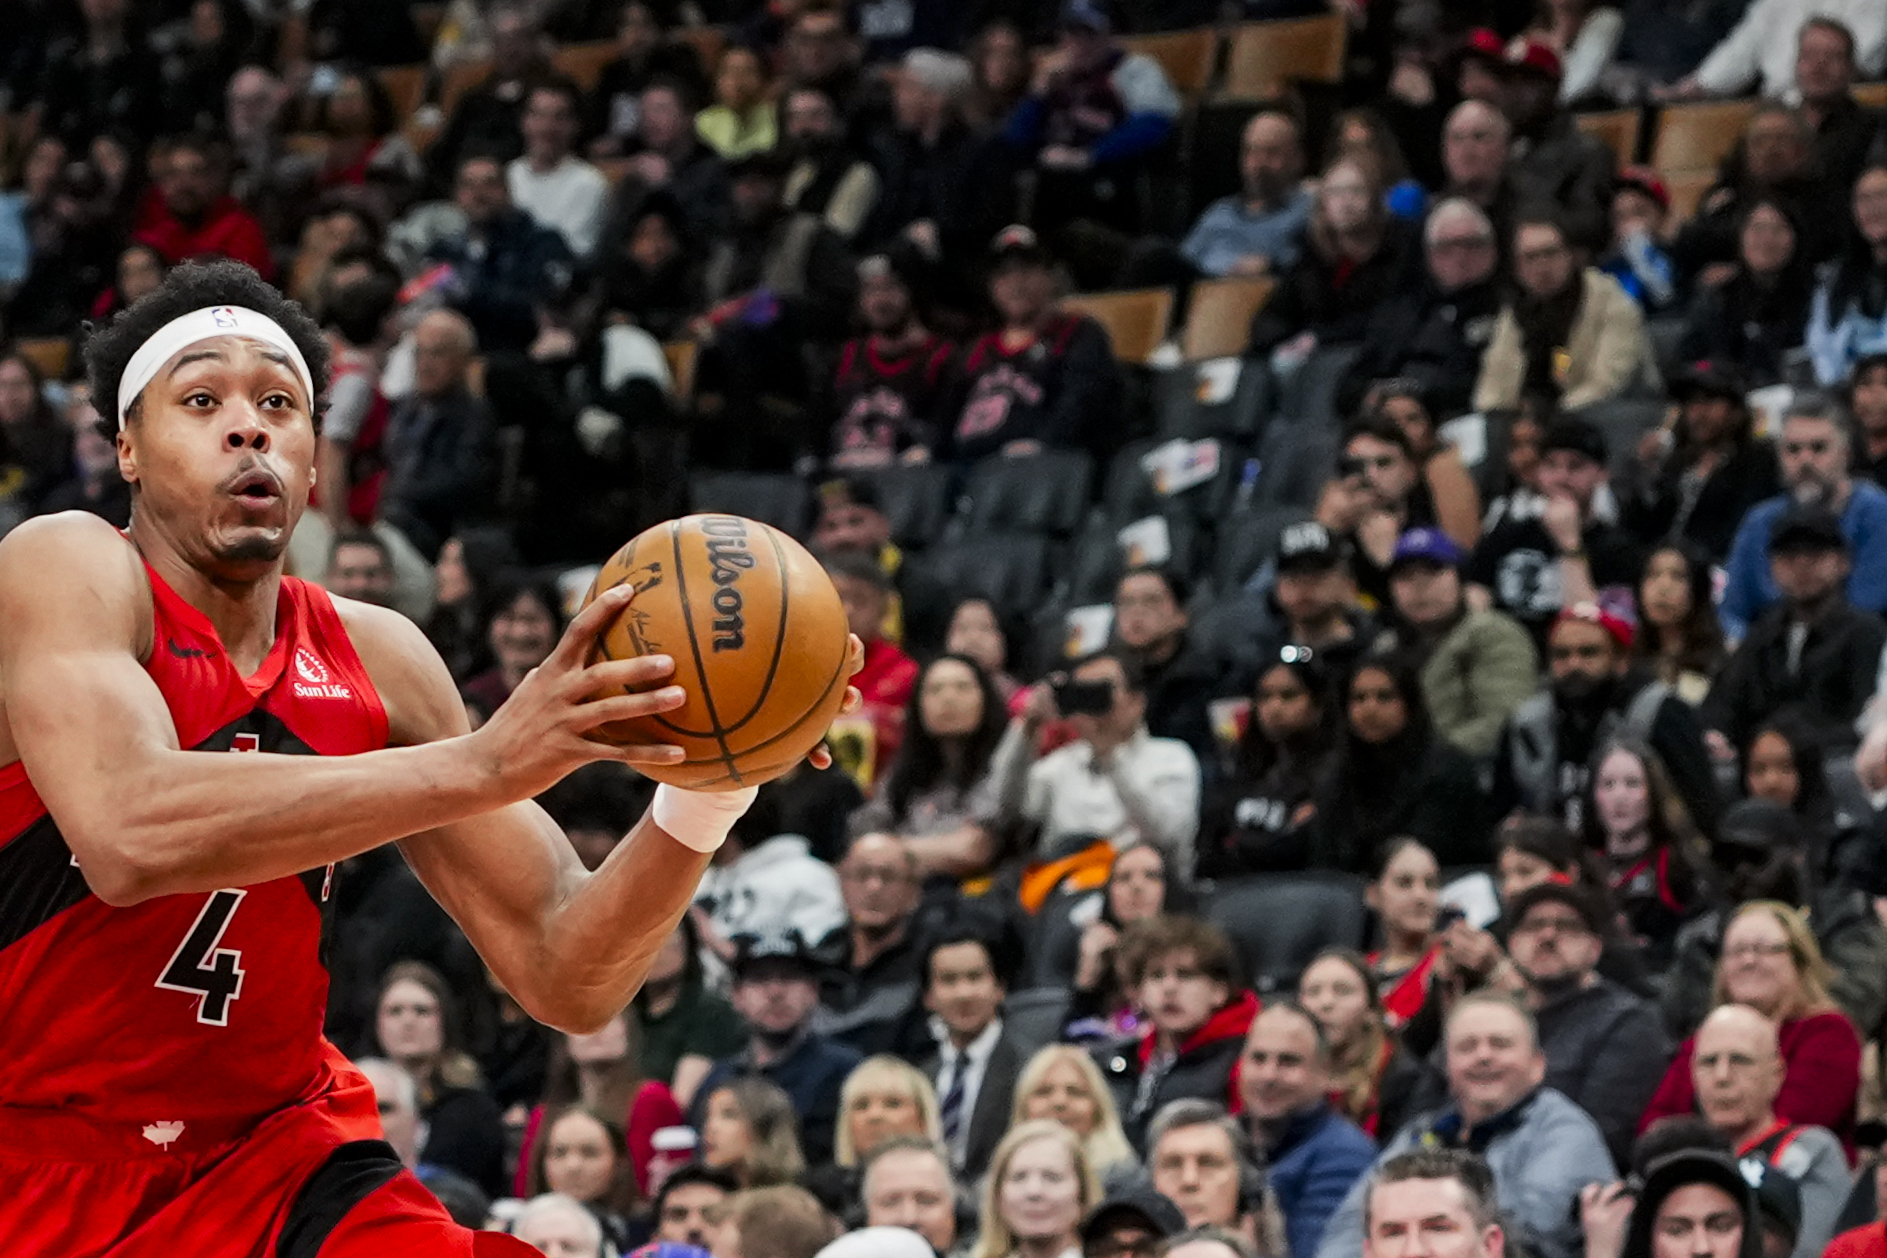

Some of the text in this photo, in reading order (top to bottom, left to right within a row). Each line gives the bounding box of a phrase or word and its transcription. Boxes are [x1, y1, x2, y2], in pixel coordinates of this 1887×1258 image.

[700, 516, 757, 653] Wilson
[294, 682, 351, 699] Sun Life
[154, 887, 248, 1027] 4
